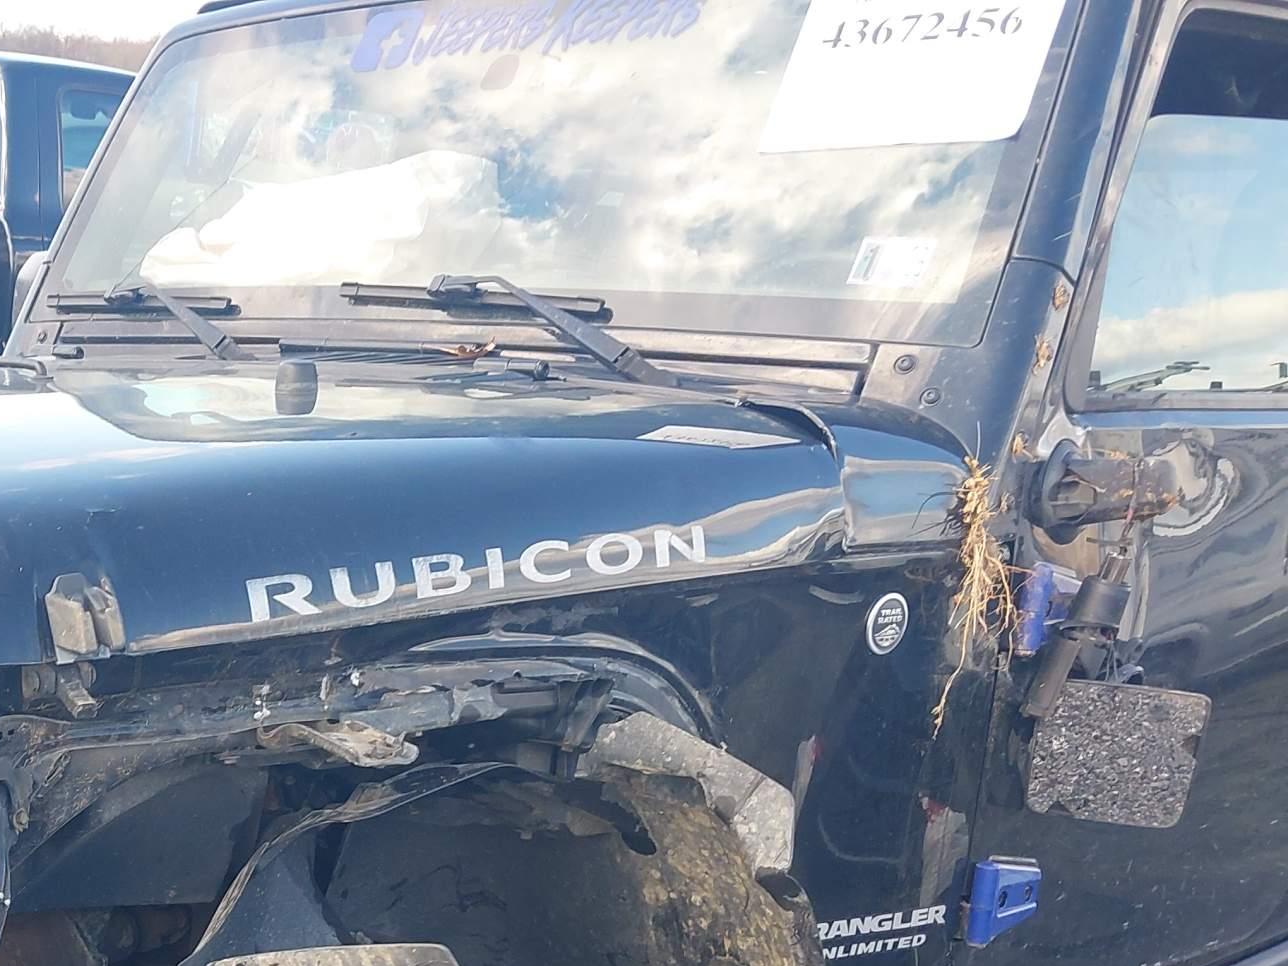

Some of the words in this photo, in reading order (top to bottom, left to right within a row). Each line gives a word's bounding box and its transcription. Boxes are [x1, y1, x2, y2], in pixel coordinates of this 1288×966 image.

[822, 7, 1023, 48] 43672456
[245, 525, 706, 622] RUBICON
[877, 615, 903, 624] RATED
[880, 607, 903, 617] TRAIL
[814, 904, 947, 940] RANGLER
[822, 934, 927, 960] NLIMITED
